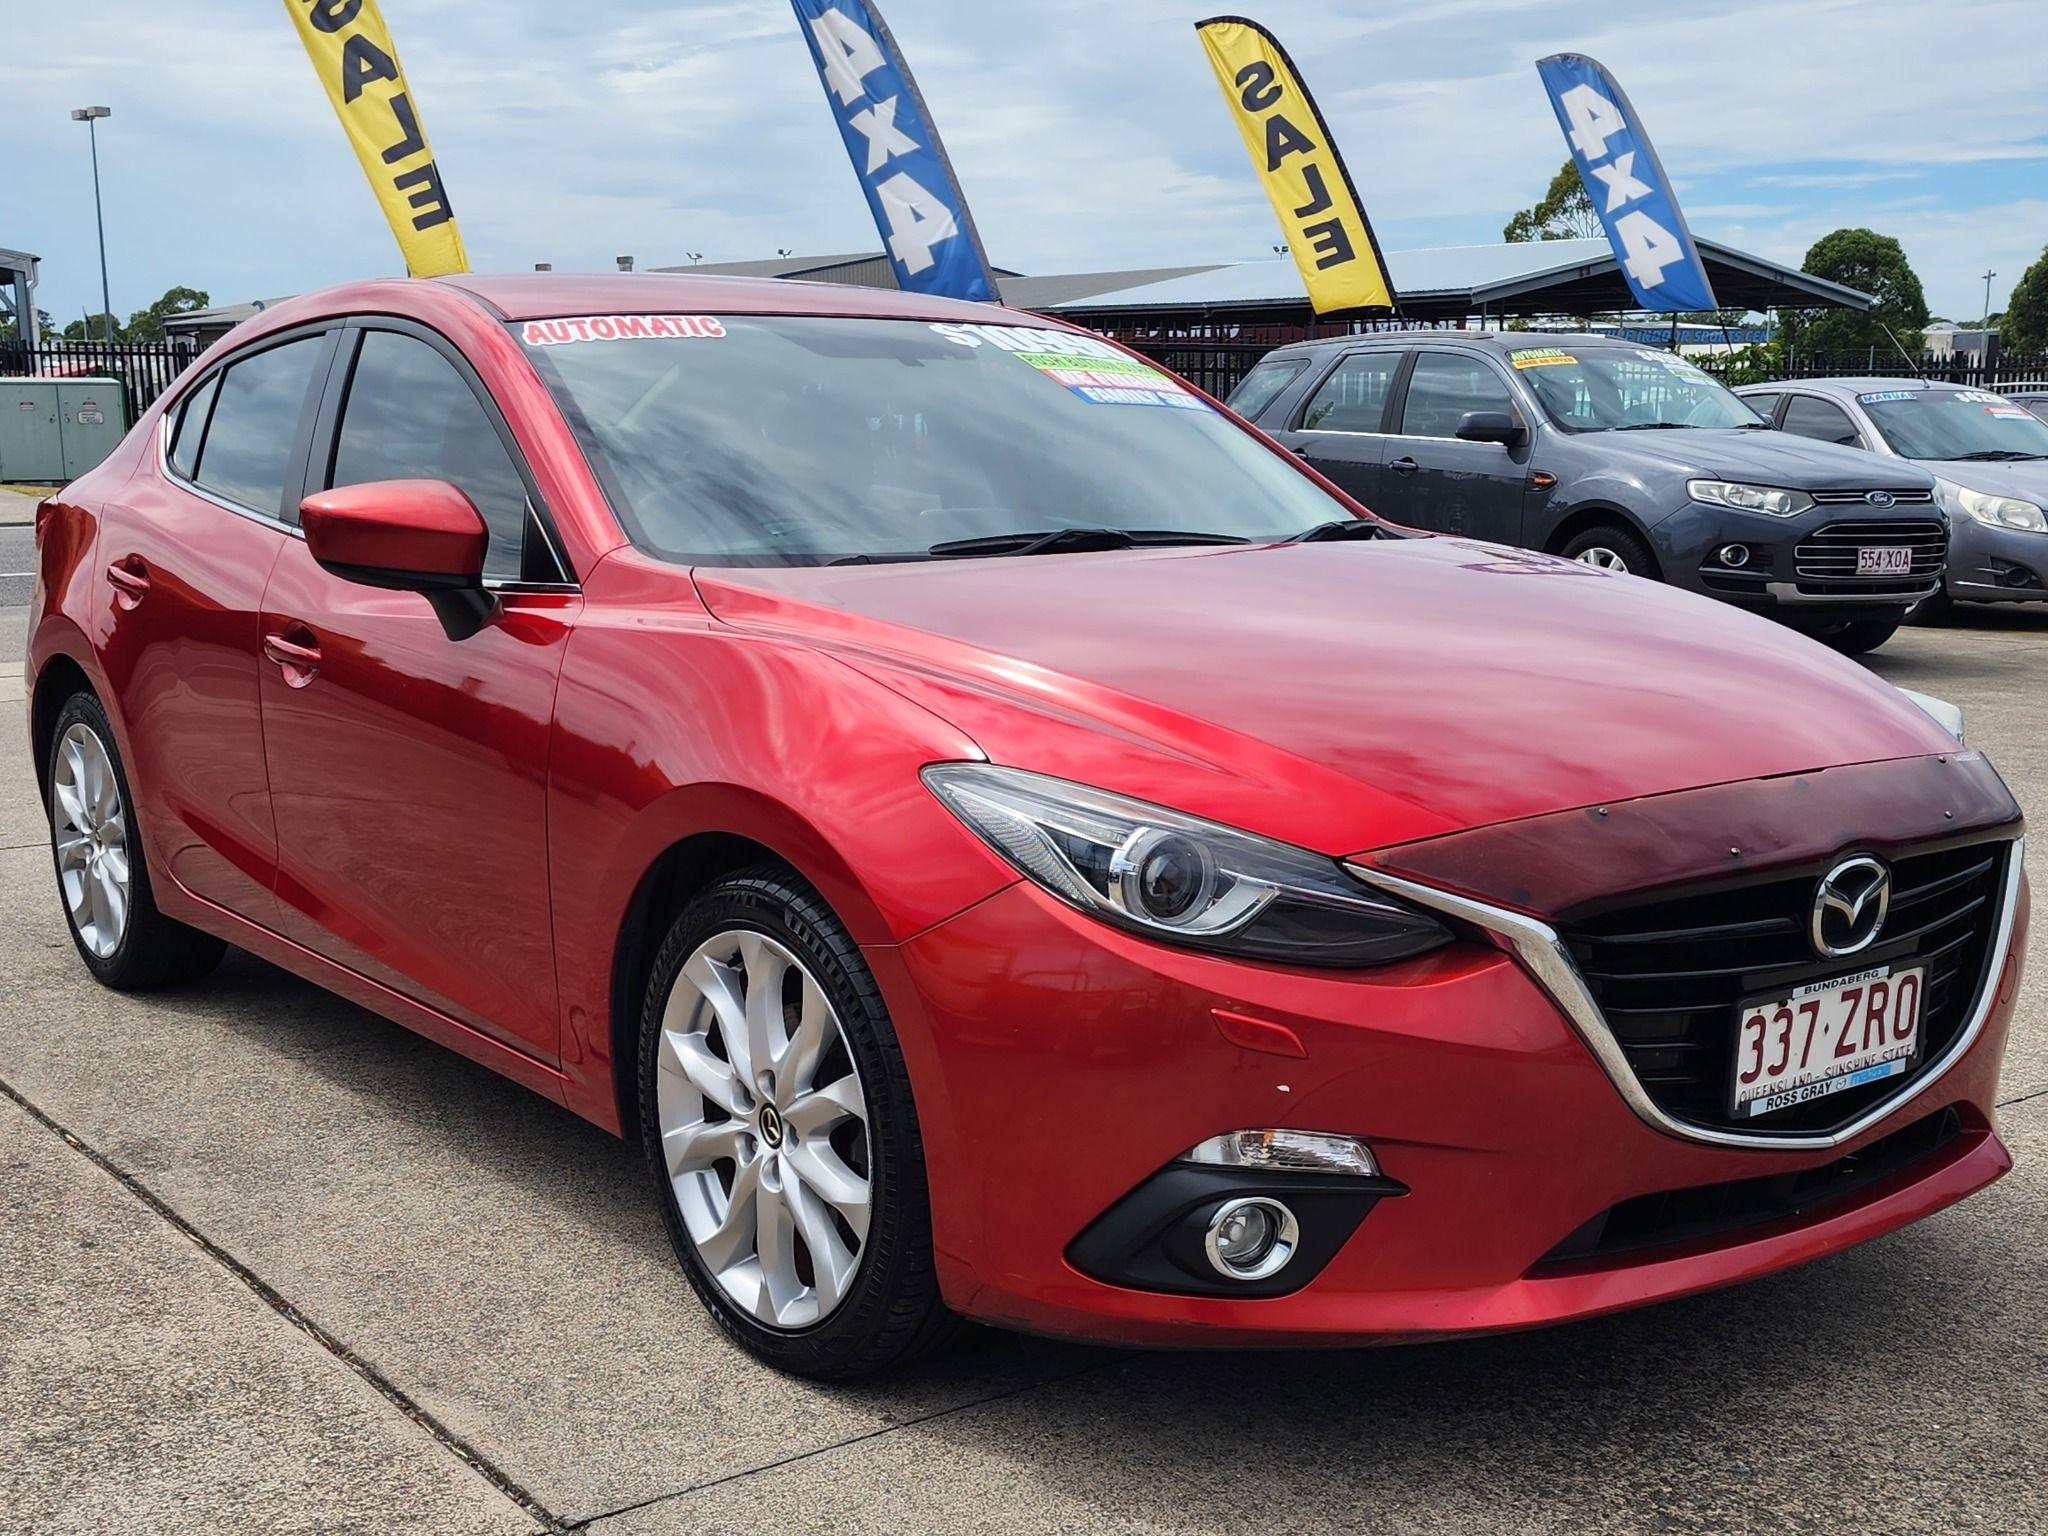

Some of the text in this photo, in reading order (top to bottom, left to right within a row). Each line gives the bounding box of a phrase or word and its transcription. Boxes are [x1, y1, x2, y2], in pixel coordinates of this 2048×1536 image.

[526, 316, 724, 345] AUTOMATIC
[1077, 386, 1165, 405] FAMILY
[1862, 391, 1917, 404] MANUAL
[1803, 969, 1880, 995] BUNDABERG
[1824, 1055, 1877, 1081] SUNSHINE
[1882, 1043, 1912, 1062] STATE
[1766, 1090, 1798, 1110] ROSS
[1801, 1080, 1833, 1100] GRAY
